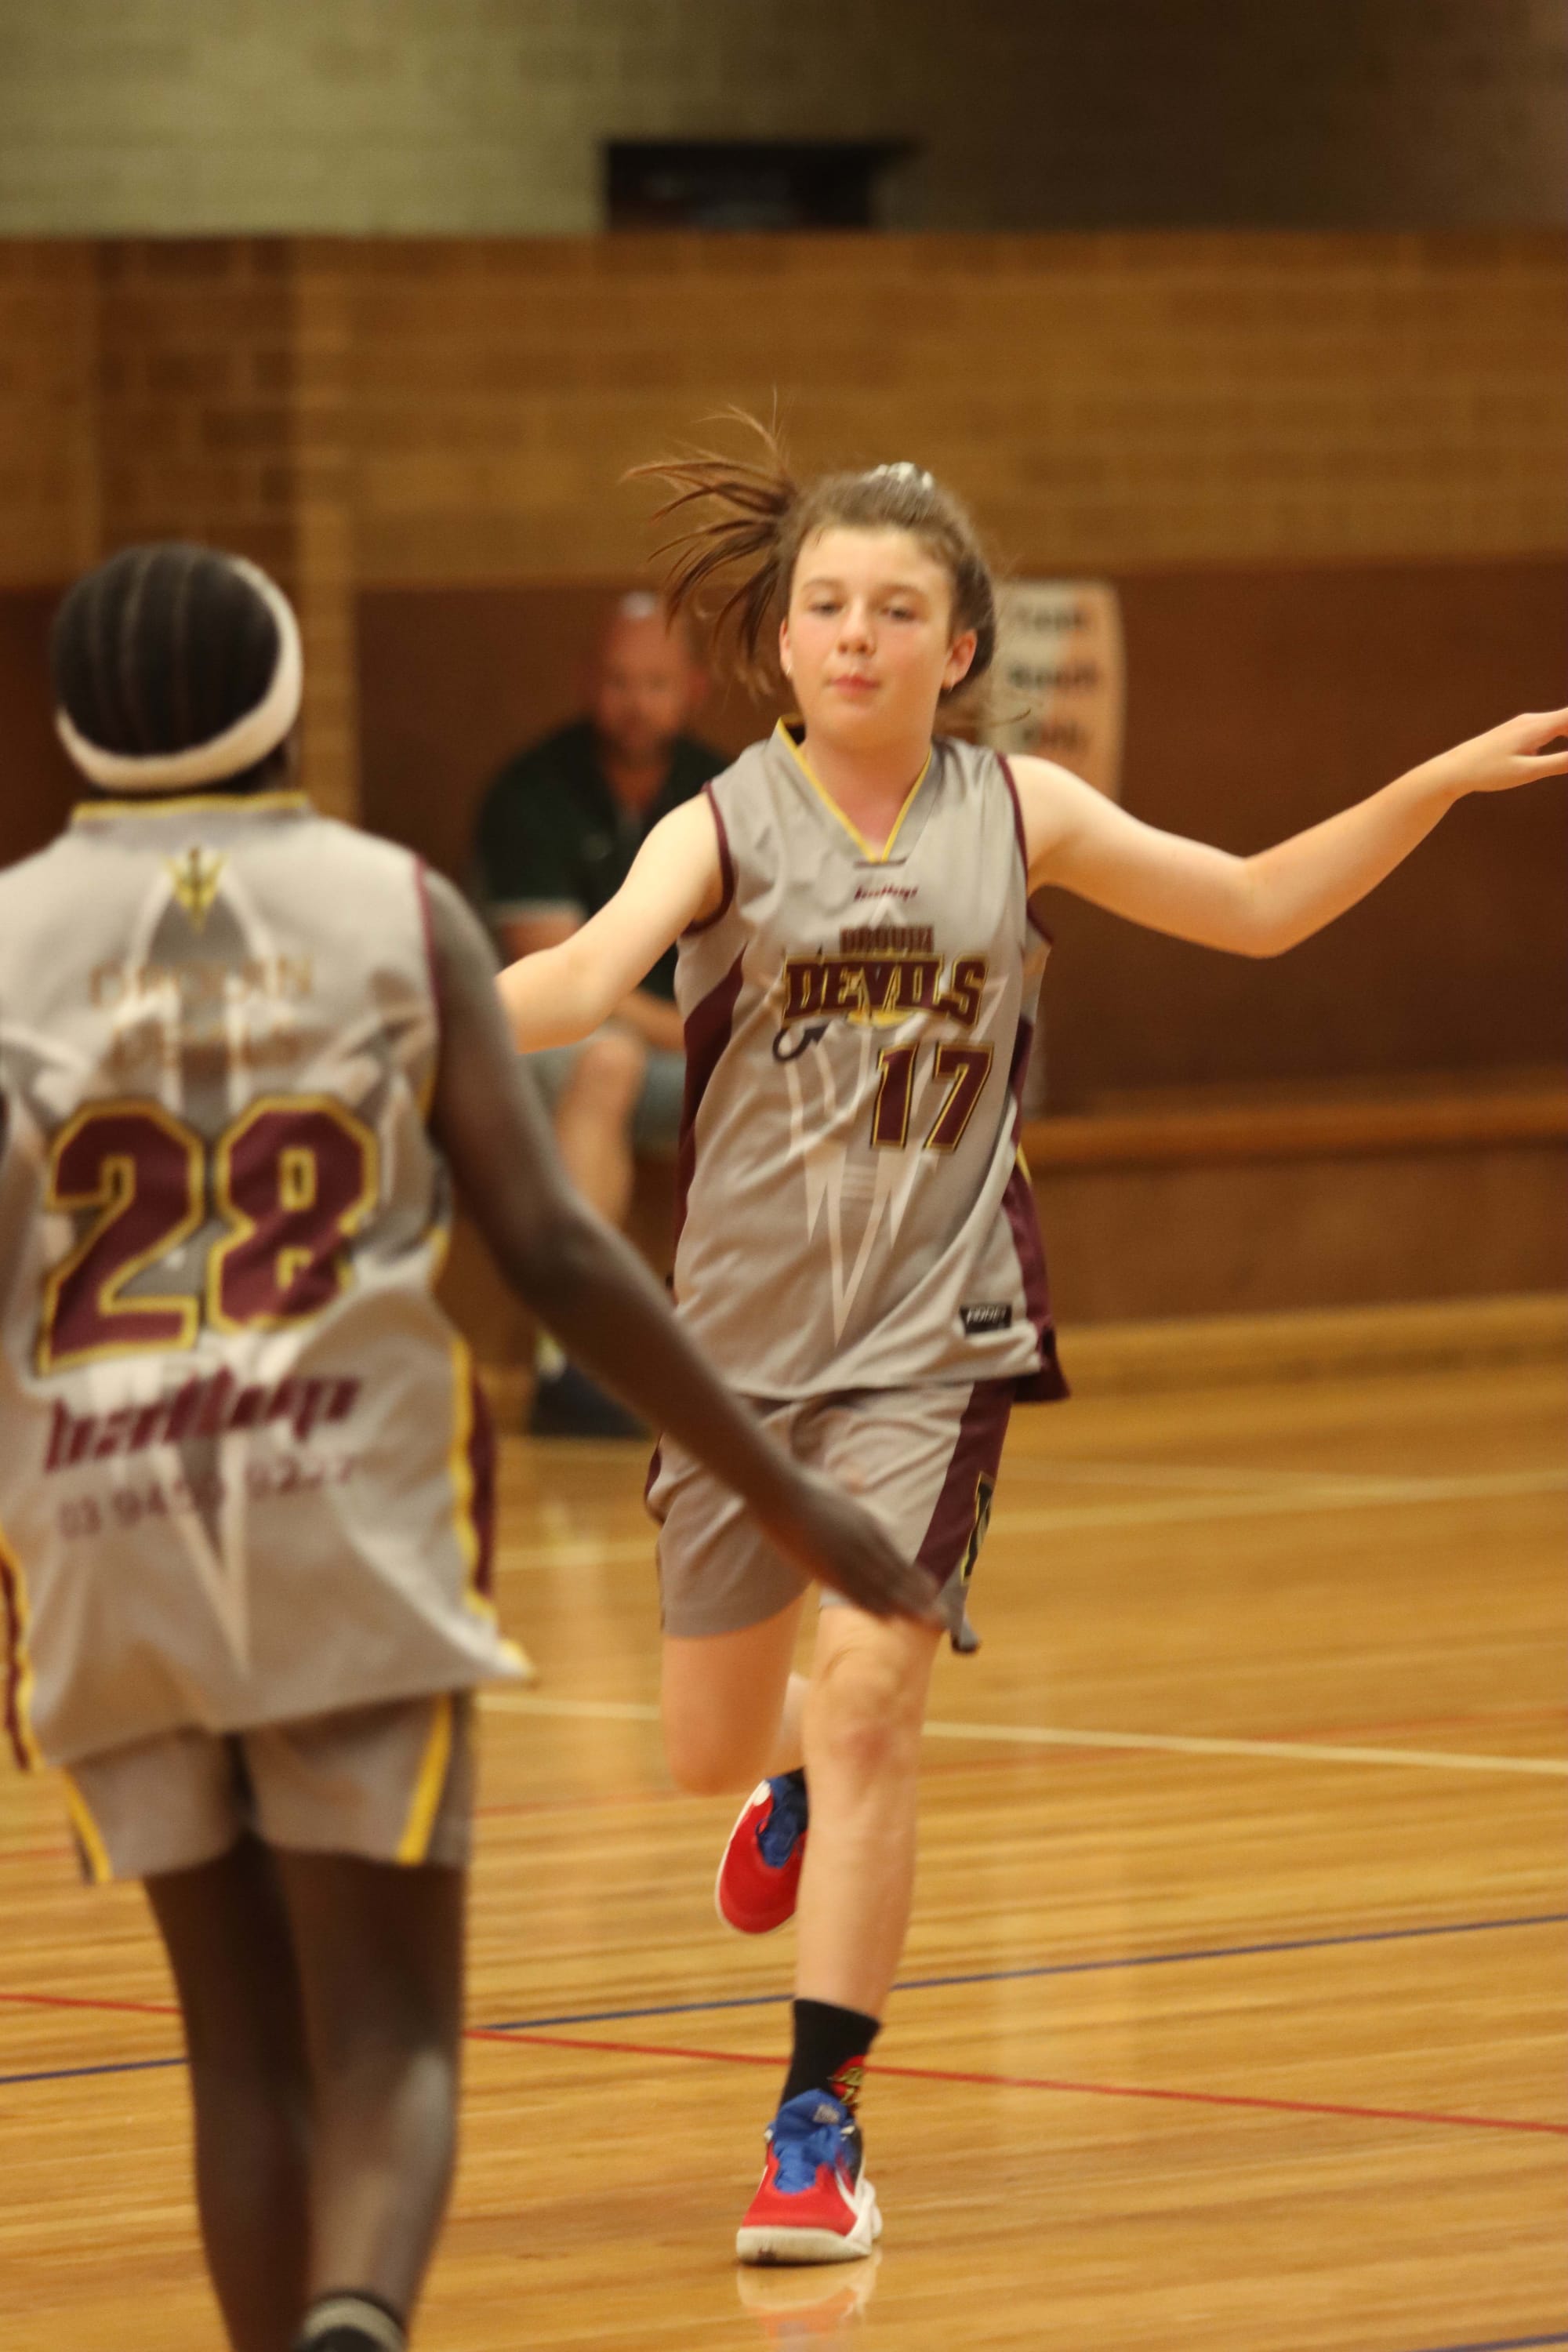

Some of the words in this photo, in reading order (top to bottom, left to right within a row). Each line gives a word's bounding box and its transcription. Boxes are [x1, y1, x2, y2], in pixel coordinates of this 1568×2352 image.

[781, 953, 989, 1027] DEVILS
[870, 1038, 994, 1154] 17
[36, 1093, 381, 1377] 28
